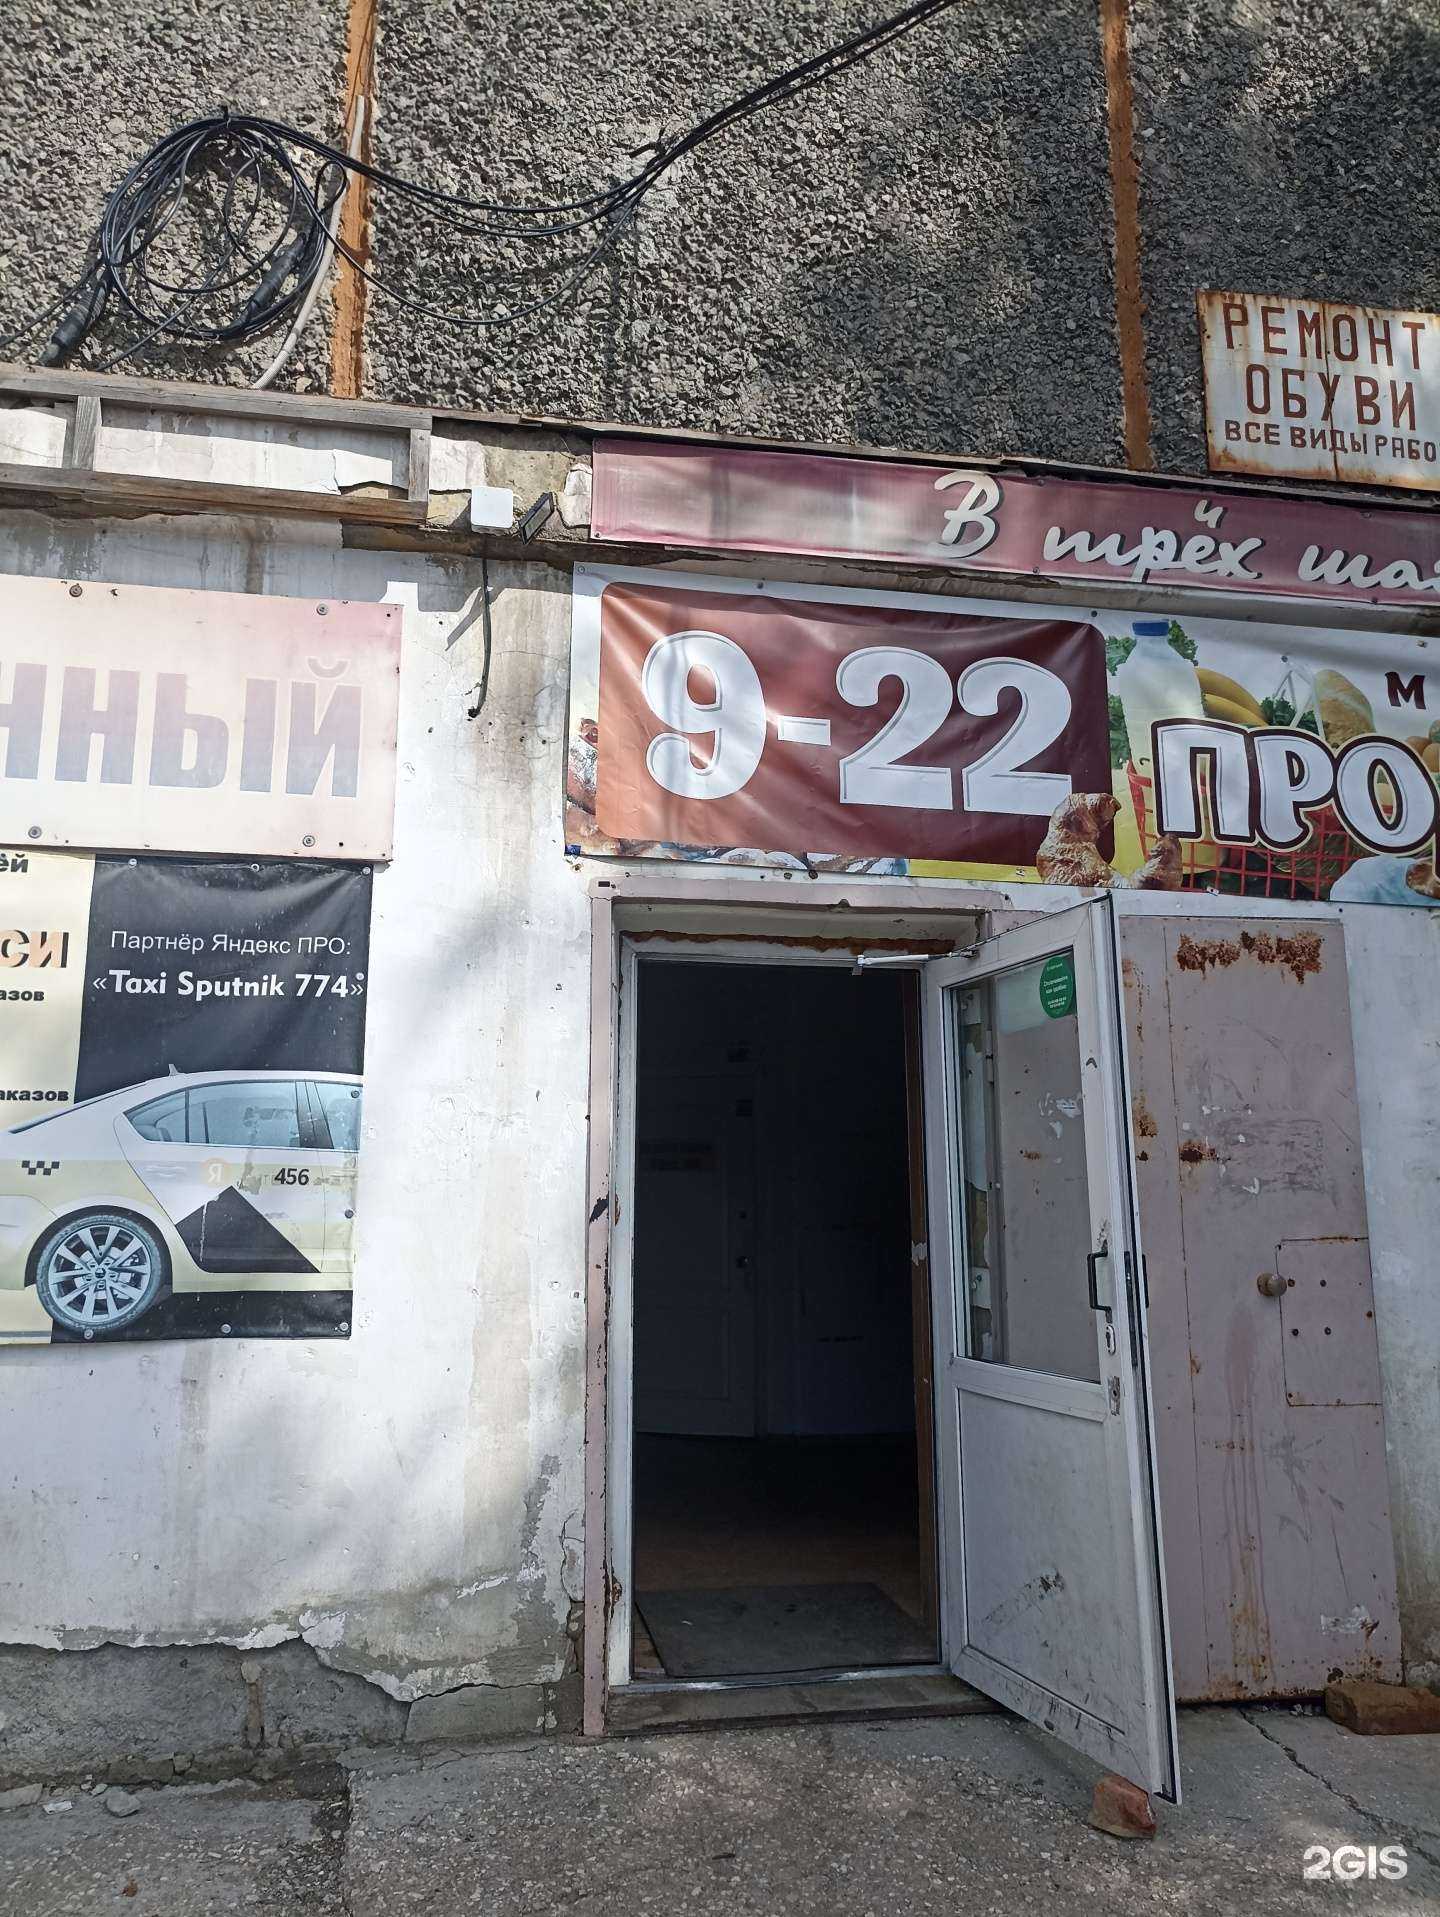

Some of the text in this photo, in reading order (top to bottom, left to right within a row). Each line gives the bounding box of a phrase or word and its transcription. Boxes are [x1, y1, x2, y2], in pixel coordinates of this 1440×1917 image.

[1222, 303, 1425, 369] РЕМОНТ
[1246, 364, 1416, 430] ОБУВИ
[1225, 419, 1440, 462] ВСЕ ВИДЫ РАБО
[934, 470, 1005, 559] В
[1299, 544, 1440, 592] ша
[1384, 671, 1426, 710] М
[641, 629, 1073, 817] 9-22
[1151, 719, 1440, 868] ПРО
[0, 929, 70, 968] СИ
[111, 930, 351, 955] Партнёр Яндекс ПРО:
[92, 969, 364, 1002] «Taxi Sputnik 774»
[274, 1167, 310, 1186] 456
